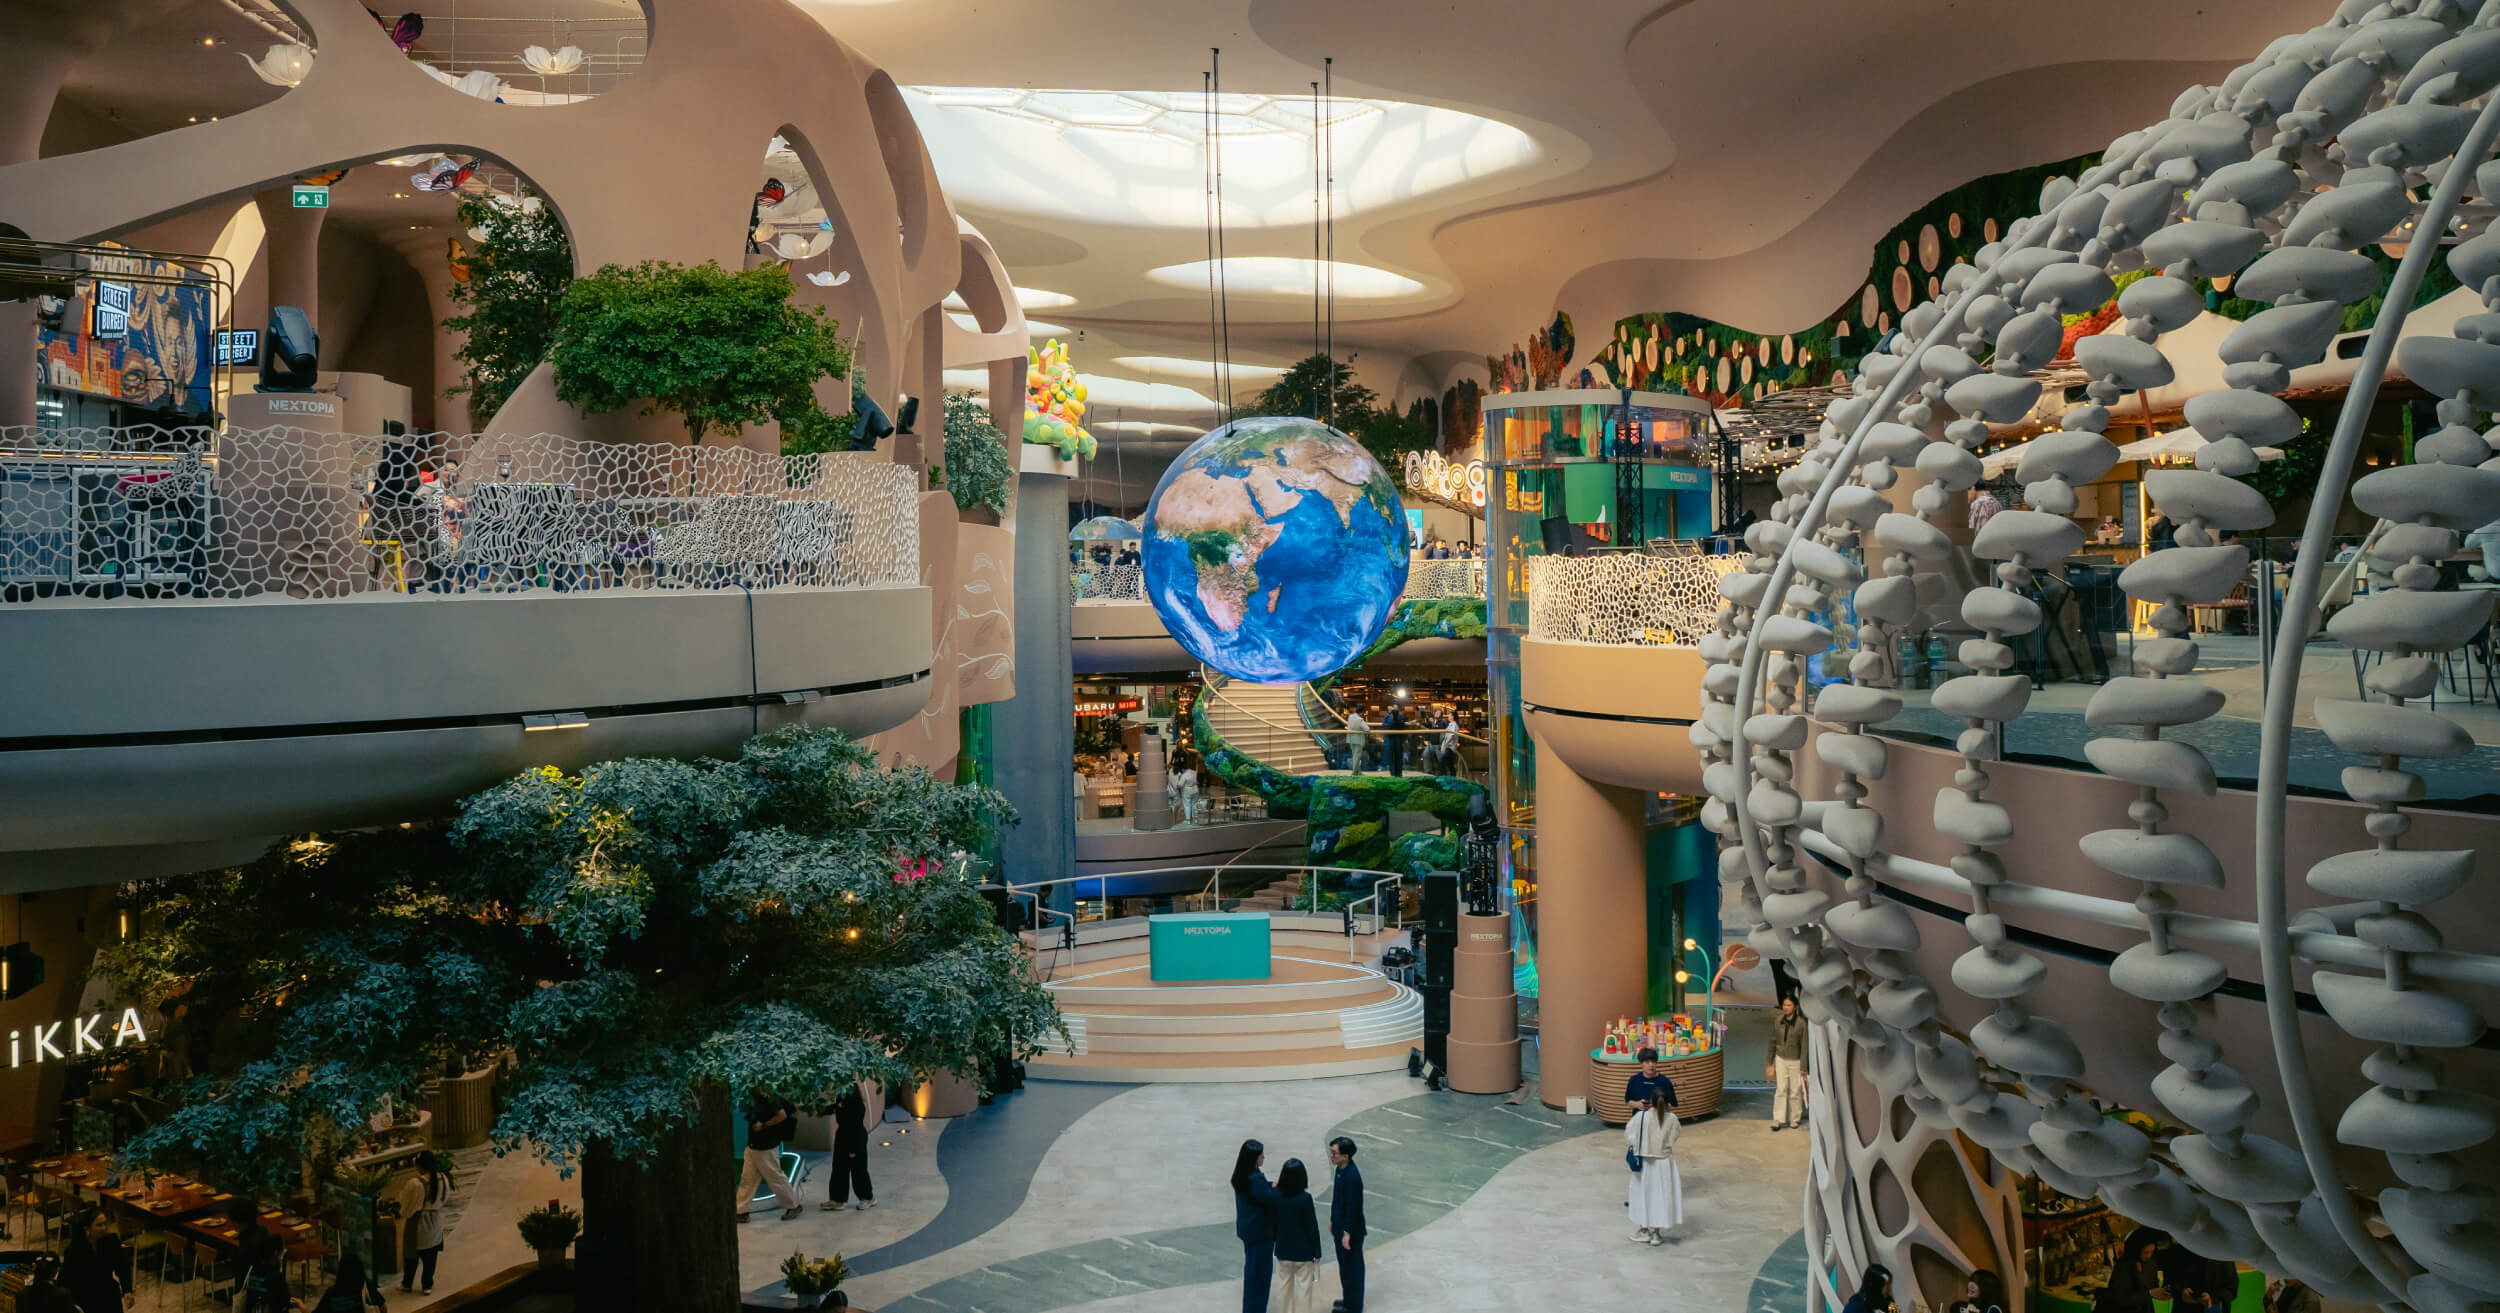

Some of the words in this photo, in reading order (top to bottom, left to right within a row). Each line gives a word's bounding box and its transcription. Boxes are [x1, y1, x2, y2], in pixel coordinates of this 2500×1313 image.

[102, 286, 127, 310] STREET
[101, 311, 124, 331] BURGER
[221, 334, 252, 346] STEET
[268, 399, 335, 414] NEXTOPIA
[1074, 702, 1115, 712] UBARU
[1183, 926, 1232, 936] NEXTOPIA
